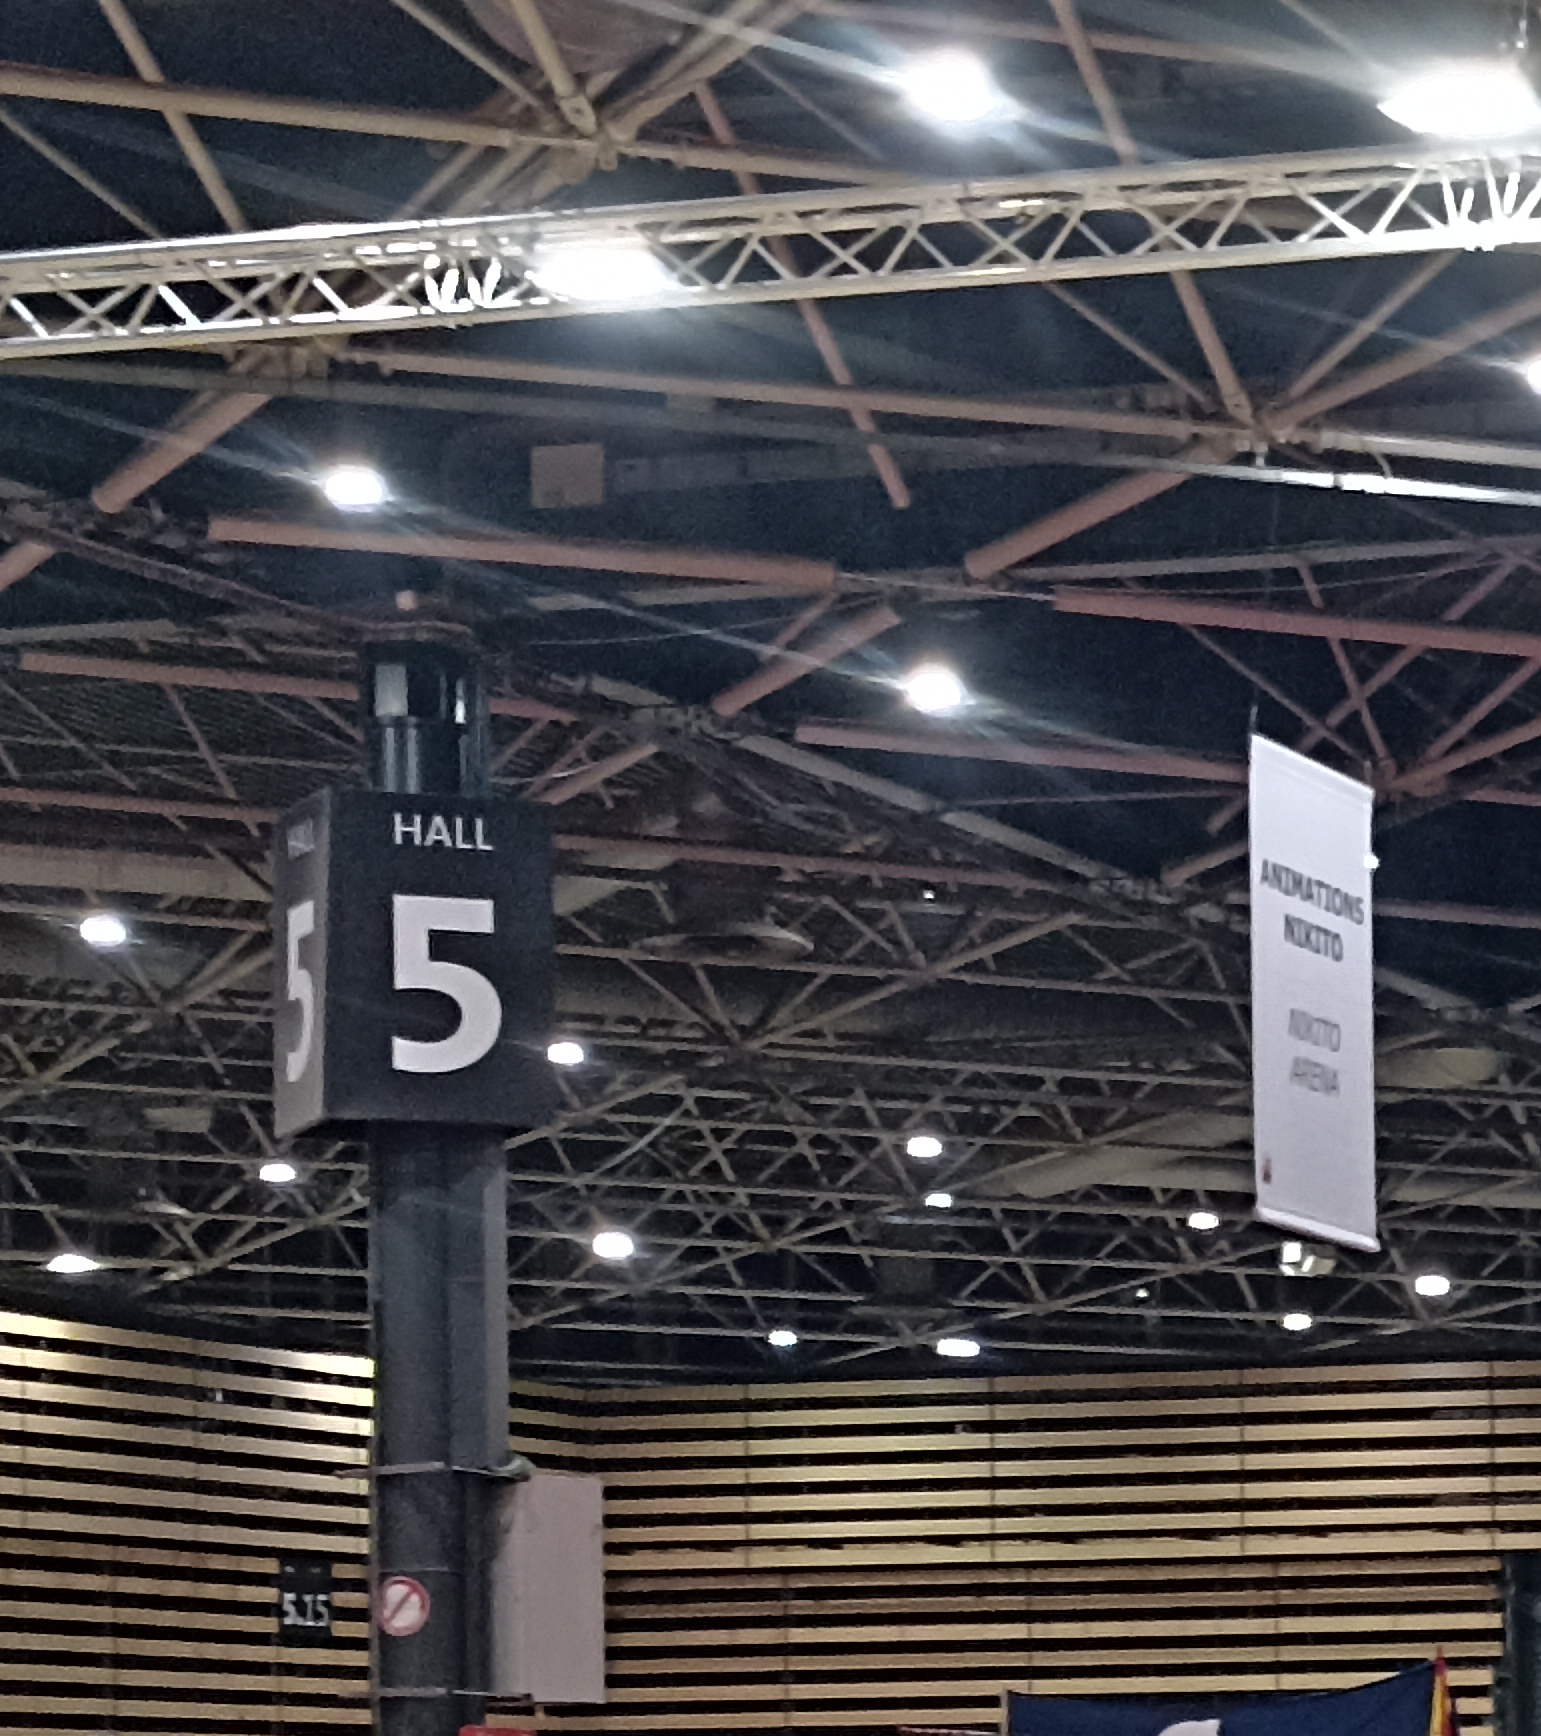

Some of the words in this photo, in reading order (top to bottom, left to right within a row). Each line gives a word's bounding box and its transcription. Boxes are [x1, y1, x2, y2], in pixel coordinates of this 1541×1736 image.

[393, 812, 495, 852] HALL
[285, 898, 316, 1083] 5
[391, 893, 503, 1074] 5
[282, 1592, 329, 1627] 5.15
